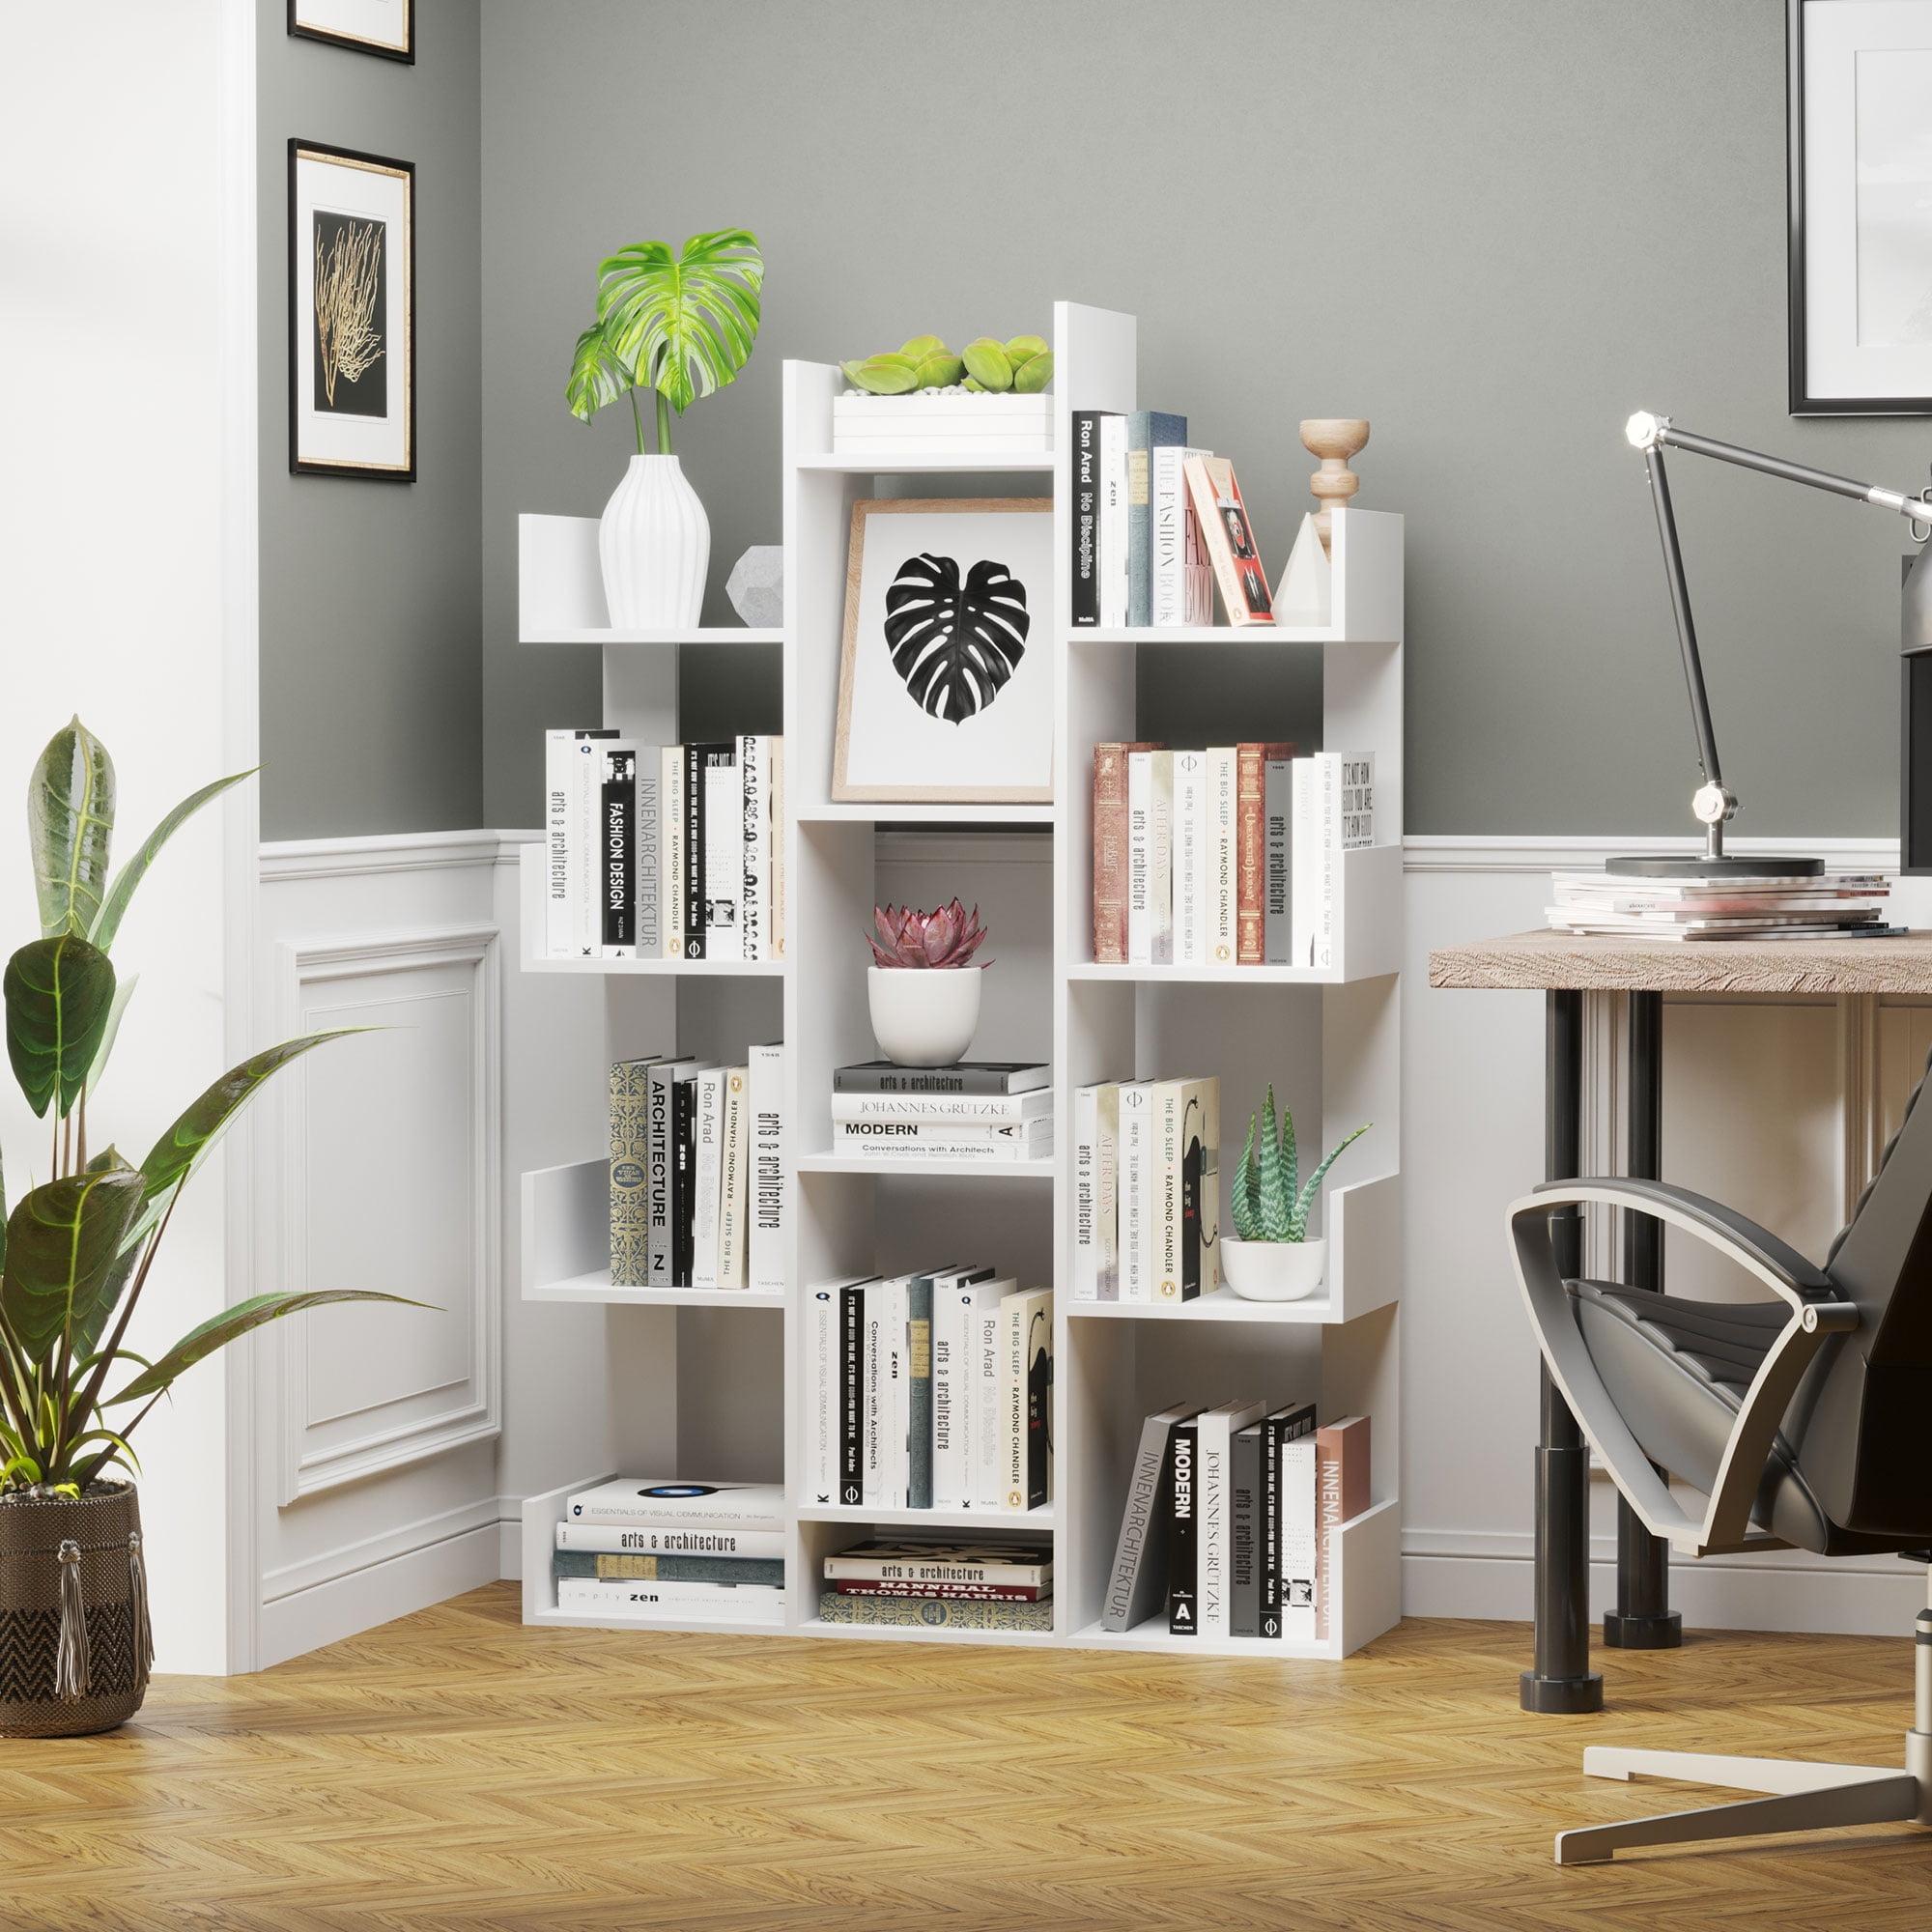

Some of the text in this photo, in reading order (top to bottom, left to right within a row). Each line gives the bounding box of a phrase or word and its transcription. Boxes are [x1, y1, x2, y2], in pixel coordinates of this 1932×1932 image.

[1081, 420, 1093, 483] Ron Arad
[1159, 449, 1175, 488] THE
[1080, 493, 1093, 579] No Discipline
[1159, 493, 1175, 567] FASHION
[551, 791, 565, 813] arts
[1133, 810, 1145, 831] arts
[610, 803, 624, 859] FASHION
[1269, 816, 1283, 836] arts
[551, 832, 568, 899] architecture
[641, 778, 657, 947] INNENARCHITEKTUR
[1133, 853, 1147, 911] architecture
[1269, 852, 1286, 915] architecture
[610, 863, 624, 910] DESIGN
[880, 1075, 963, 1092] arts & architecture
[702, 1082, 715, 1144] Ron Arad
[758, 1113, 782, 1136] arts
[860, 1101, 937, 1114] JOHANNES
[845, 1123, 918, 1136] MODERN
[999, 1126, 1012, 1136] A
[652, 1081, 665, 1227] ARCHITECTURE
[1079, 1145, 1090, 1165] arts
[1101, 1134, 1112, 1214] AFTER DAYS
[727, 1152, 736, 1200] RAYMOND
[758, 1156, 784, 1229] architecture
[1079, 1182, 1093, 1245] architecture
[654, 1254, 665, 1270] Z
[869, 1321, 878, 1393] Conversations
[937, 1341, 950, 1363] arts
[983, 1320, 995, 1378] Ron Arad
[869, 1396, 878, 1416] with
[937, 1381, 951, 1450] architecture
[817, 1494, 829, 1503] K
[1175, 1438, 1190, 1519] MODERN
[1207, 1449, 1221, 1540] JOHANNES
[1236, 1489, 1251, 1509] arts
[591, 1507, 636, 1517] ESSENTIALS
[650, 1510, 676, 1519] VISUAL
[676, 1511, 741, 1520] COMMUNICATION
[962, 1499, 970, 1508] K
[622, 1532, 736, 1551] arts & architecture
[1109, 1451, 1159, 1619] INNENARCHITEKTUR
[1236, 1524, 1255, 1585] architecture
[879, 1582, 996, 1592] HANNIBAL
[881, 1565, 983, 1580] arts & architecture
[846, 1588, 1028, 1602] THOMAS HARRIS
[1176, 1604, 1190, 1619] A
